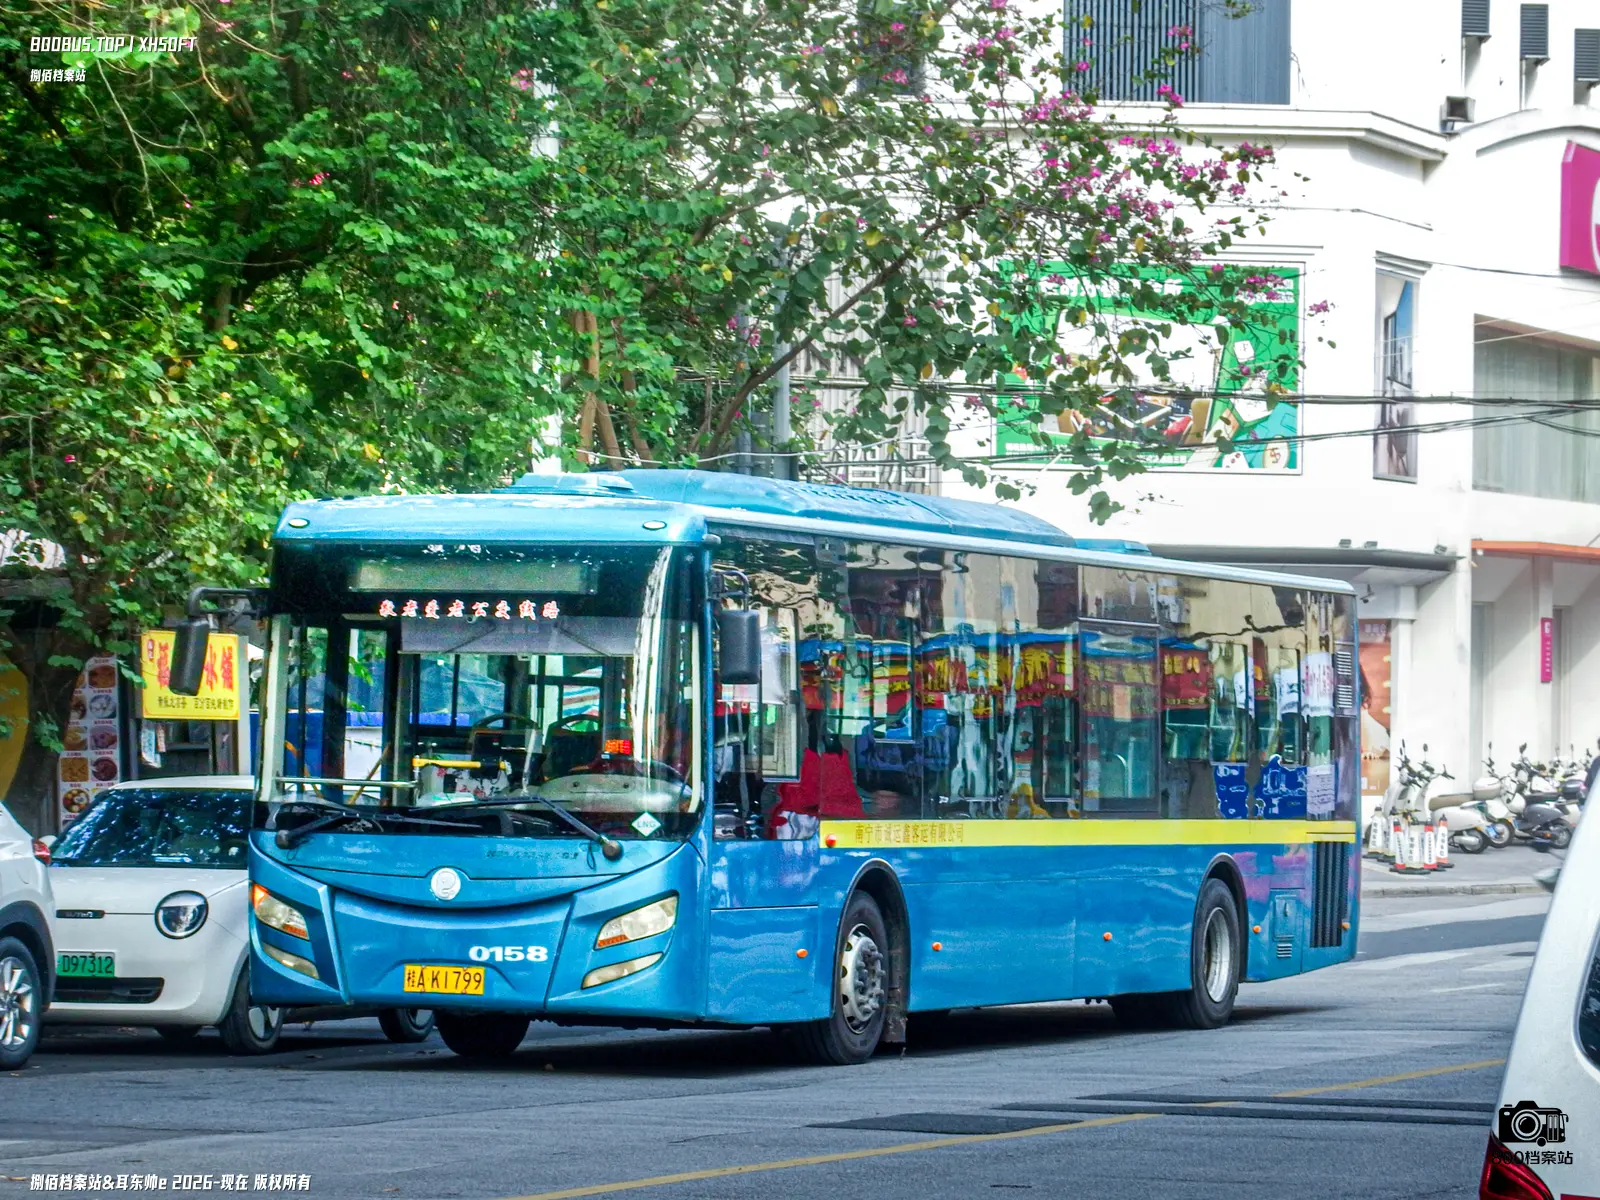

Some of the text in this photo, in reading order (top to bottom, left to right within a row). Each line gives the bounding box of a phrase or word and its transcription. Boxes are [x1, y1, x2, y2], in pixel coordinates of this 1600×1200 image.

[378, 598, 561, 621] 敬老爱老公交线路
[61, 954, 114, 974] D97312
[468, 945, 549, 963] 0158
